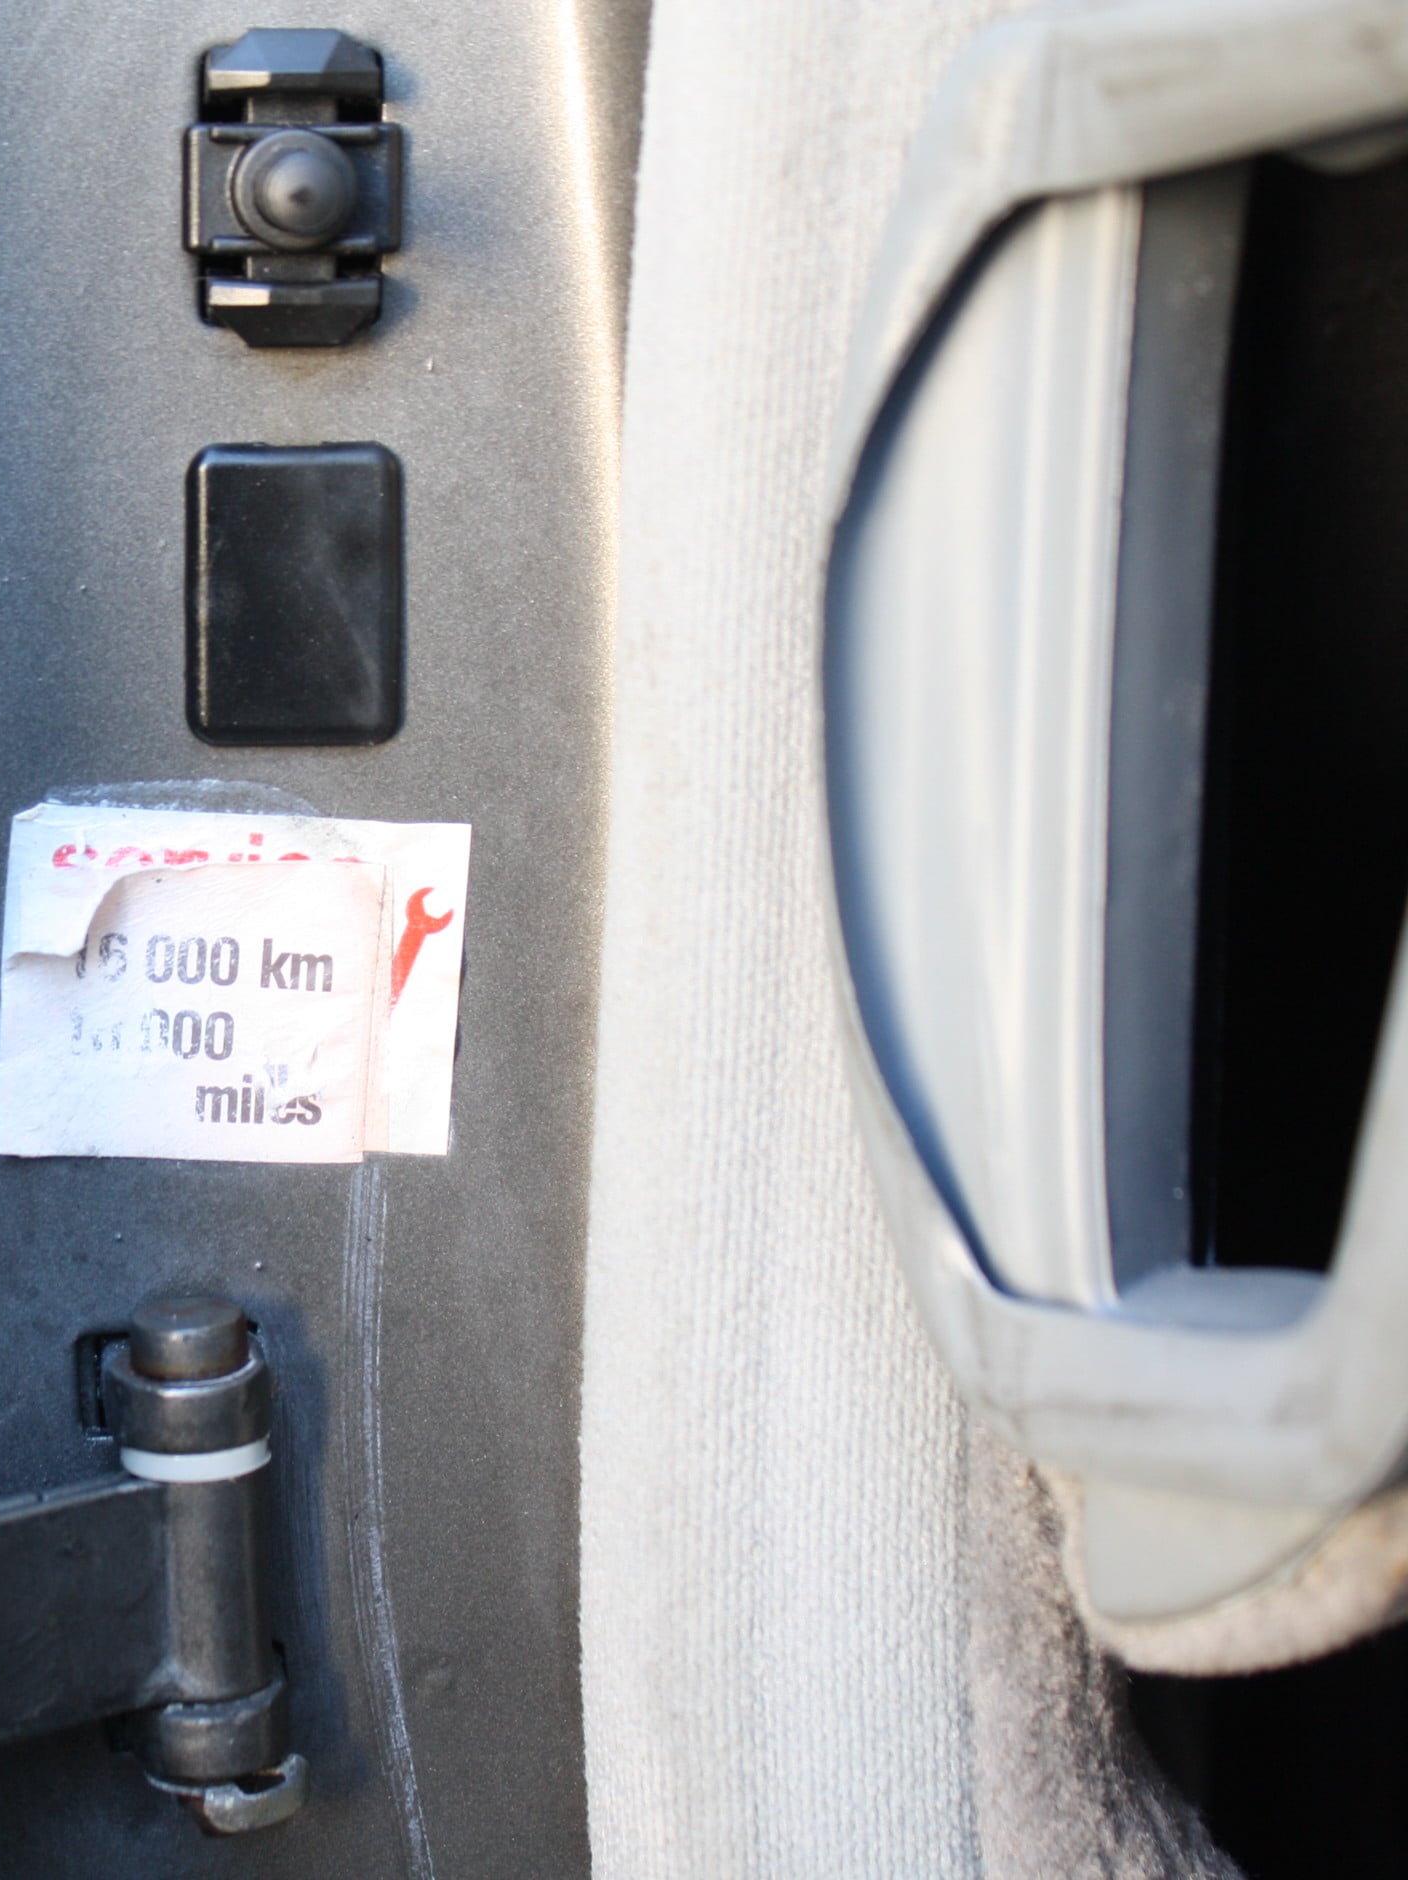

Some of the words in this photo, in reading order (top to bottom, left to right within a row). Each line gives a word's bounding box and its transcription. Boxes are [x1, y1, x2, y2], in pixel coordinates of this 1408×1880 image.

[144, 933, 241, 987] 000
[259, 937, 335, 993] km
[140, 1007, 235, 1061] 000
